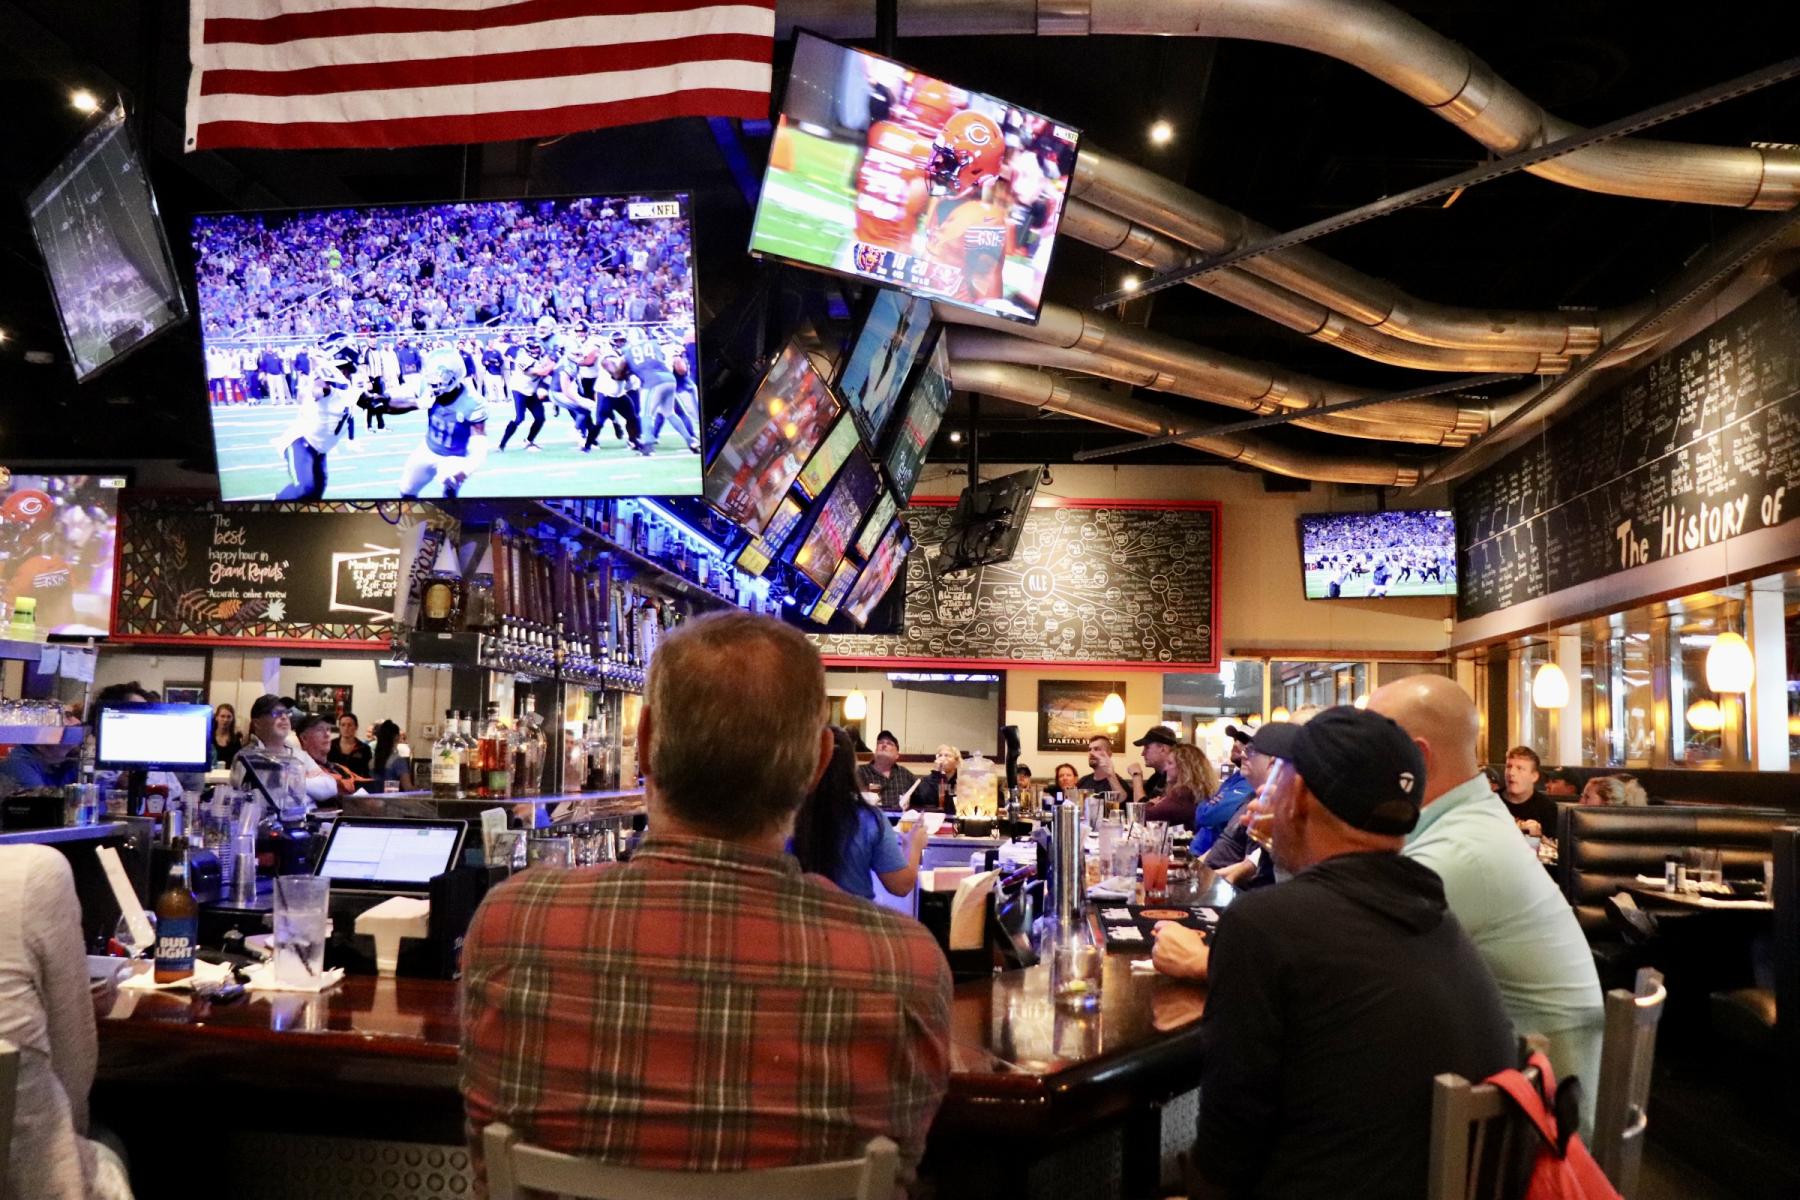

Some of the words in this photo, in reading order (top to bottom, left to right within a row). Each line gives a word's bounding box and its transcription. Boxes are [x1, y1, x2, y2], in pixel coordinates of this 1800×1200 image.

[631, 343, 656, 366] 94
[213, 526, 247, 546] best
[1616, 518, 1649, 569] The
[208, 546, 237, 565] happy
[238, 547, 258, 560] hour
[260, 549, 269, 562] in
[1028, 574, 1049, 592] ALE
[160, 937, 189, 948] BUD
[155, 947, 193, 959] LIGHT
